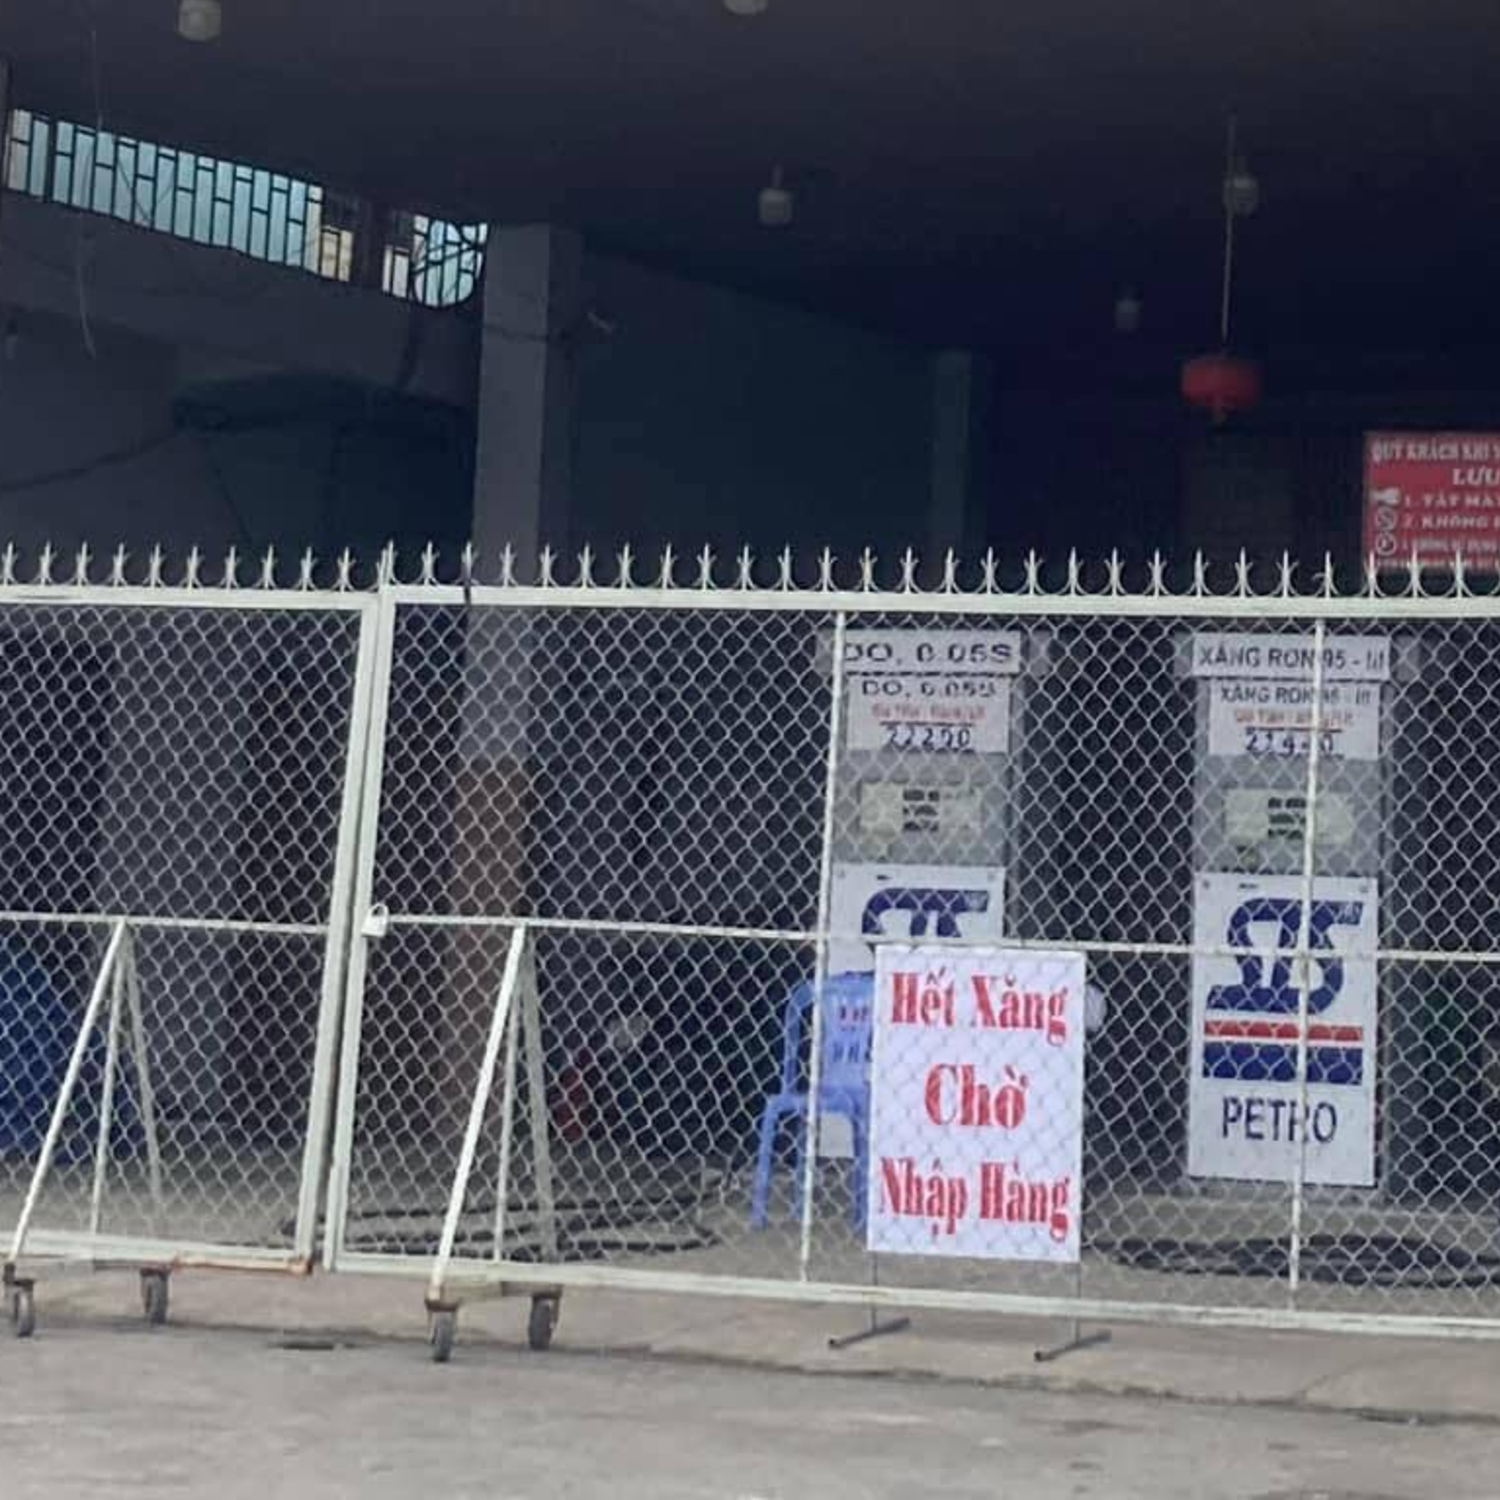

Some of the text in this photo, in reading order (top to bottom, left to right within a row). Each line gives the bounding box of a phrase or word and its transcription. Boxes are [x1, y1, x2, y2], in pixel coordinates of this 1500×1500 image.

[1452, 465, 1500, 486] LƯU
[891, 966, 1069, 1047] Hết Xăng
[924, 1062, 1030, 1130] Chờ
[879, 1156, 1070, 1243] Nhập Hàng
